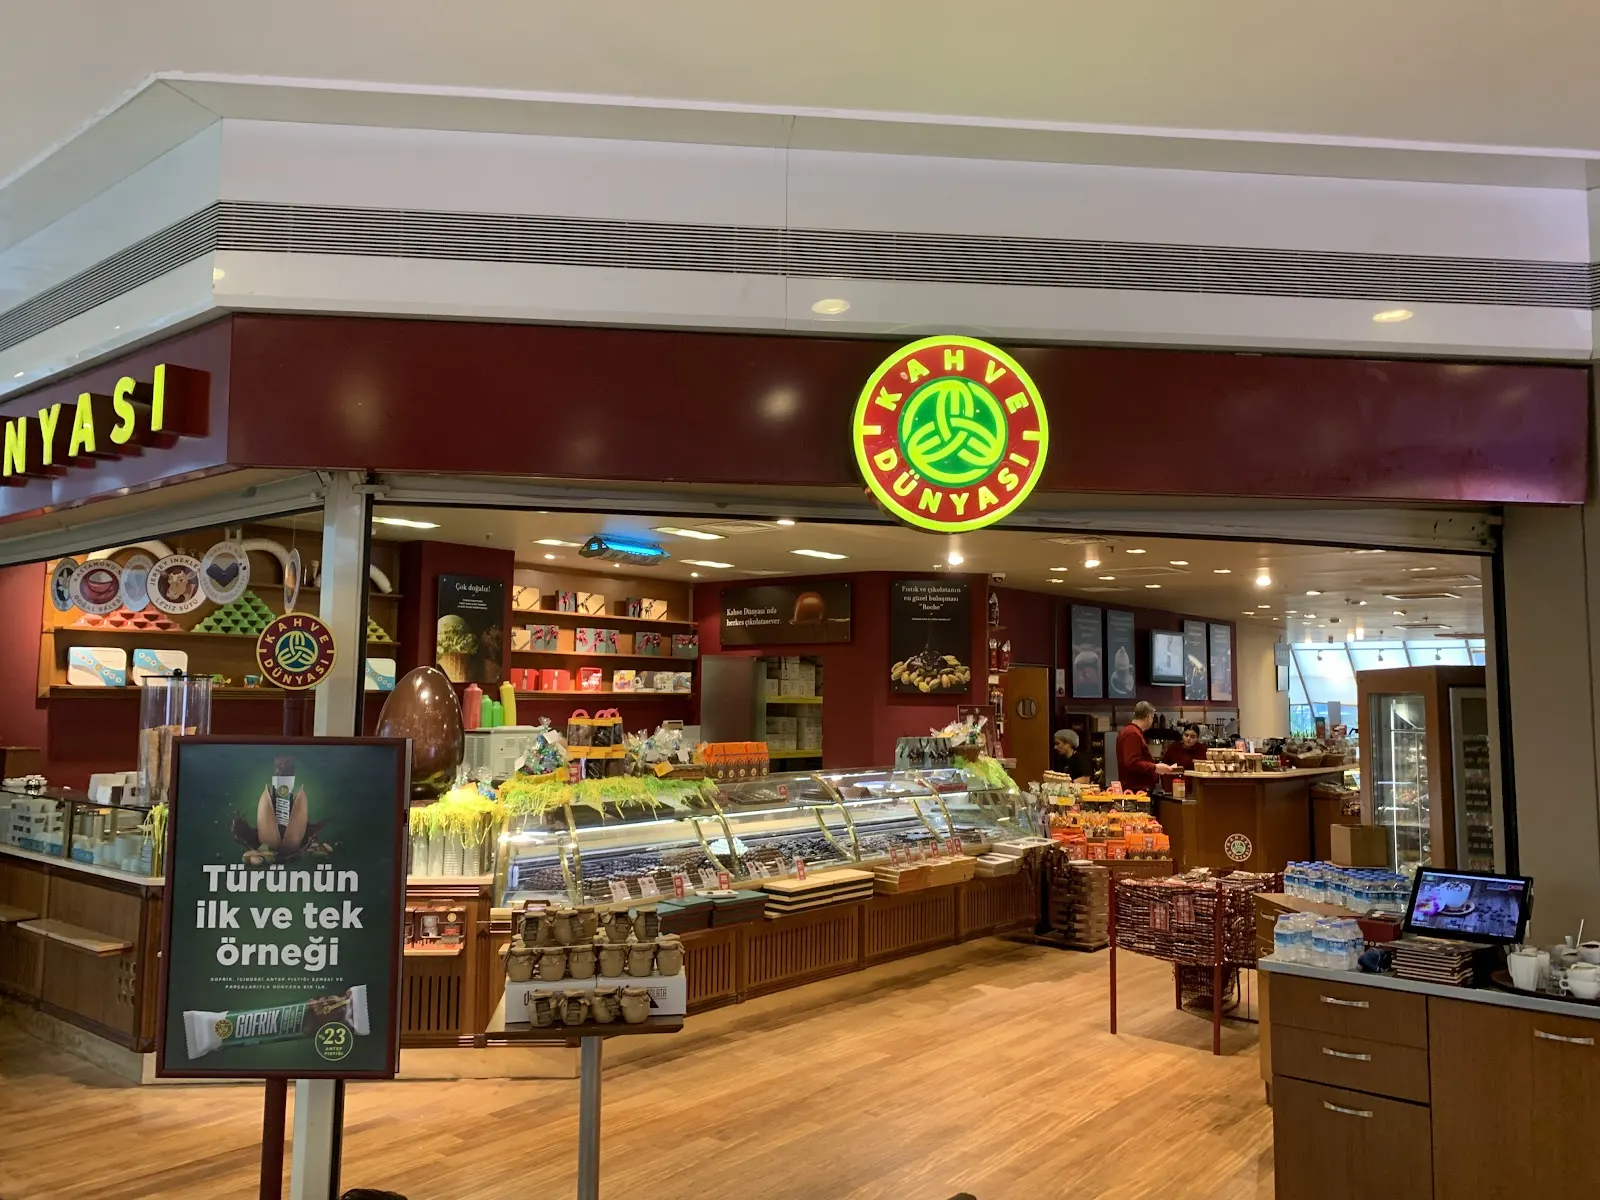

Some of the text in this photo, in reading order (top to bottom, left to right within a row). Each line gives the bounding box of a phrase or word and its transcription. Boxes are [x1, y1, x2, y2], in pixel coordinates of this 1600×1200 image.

[874, 348, 1030, 415] KAHVE
[3, 363, 166, 477] NYASI
[873, 447, 1030, 516] DÜNYASI
[150, 560, 168, 586] JERSEY
[455, 582, 491, 594] Çok doğalız!
[912, 595, 928, 603] güzel
[928, 594, 959, 603] buluşması
[726, 608, 743, 616] Kahve
[726, 618, 744, 627] herkes
[264, 617, 330, 644] KAHVE
[263, 658, 330, 685] DÜNYASI
[202, 863, 359, 893] Türünün
[196, 900, 364, 929] ilk ve tek
[216, 936, 339, 972] örneği
